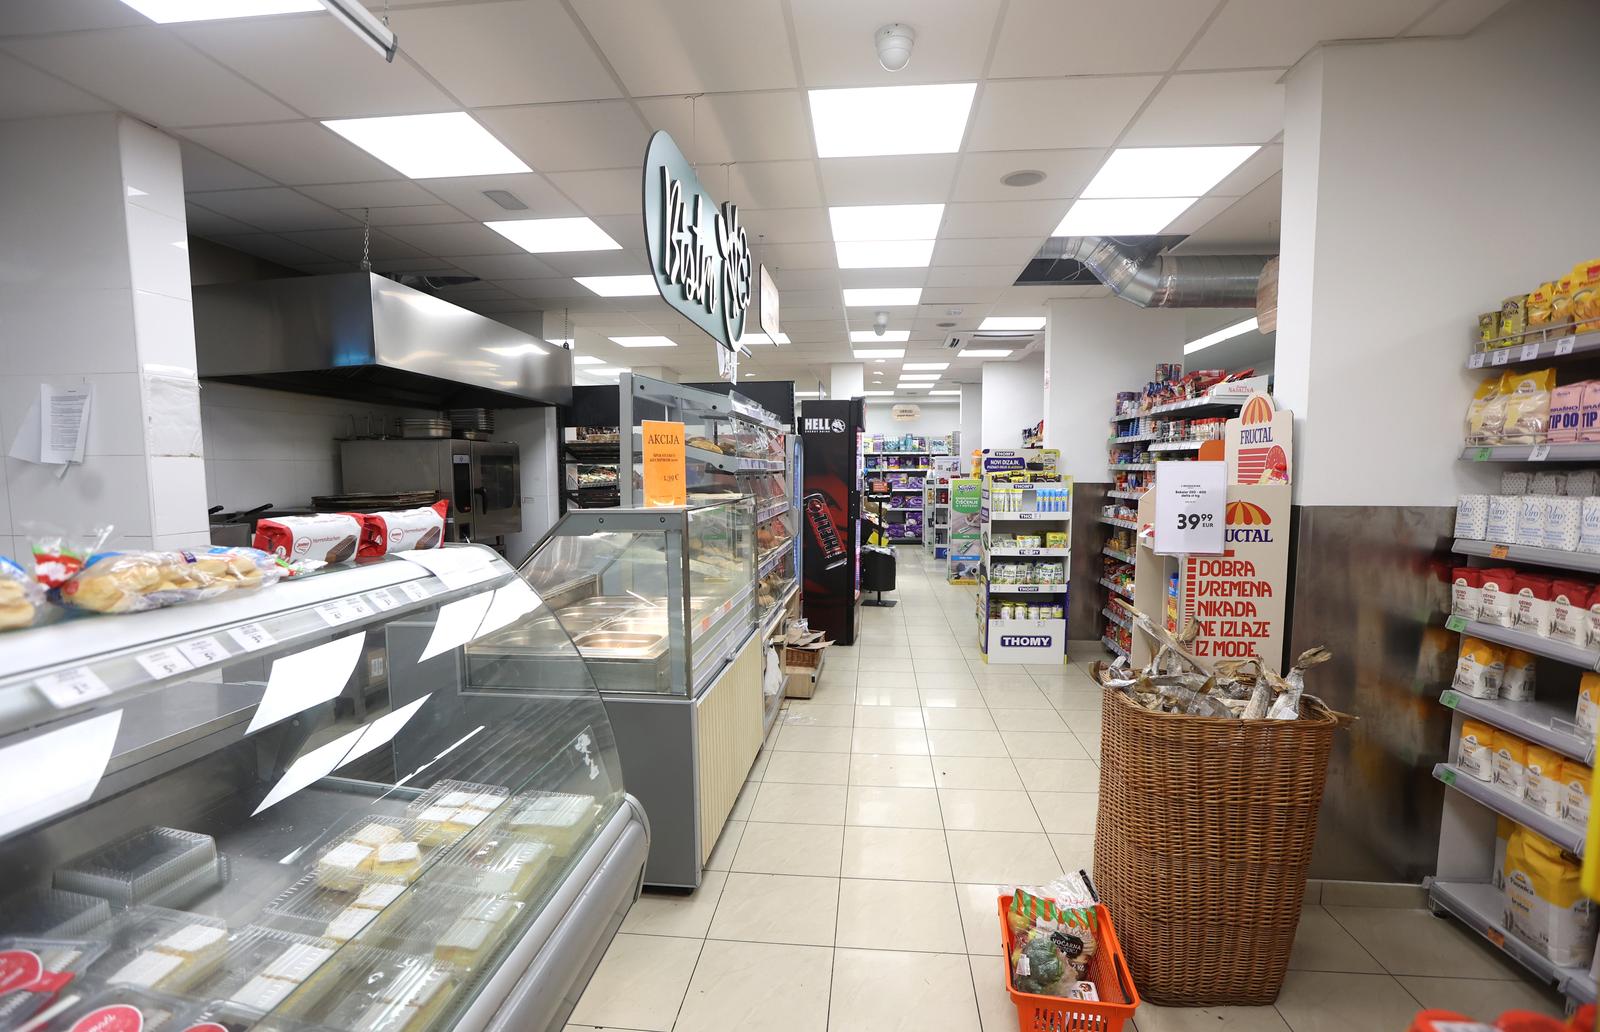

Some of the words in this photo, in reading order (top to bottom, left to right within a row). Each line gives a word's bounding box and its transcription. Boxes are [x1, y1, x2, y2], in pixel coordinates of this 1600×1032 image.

[805, 418, 830, 430] HELL
[1549, 414, 1562, 429] TIP
[1582, 411, 1598, 428] TIP
[648, 434, 680, 445] AKCIJA
[1240, 427, 1273, 445] FRUCTAL
[958, 484, 977, 492] Swiffer
[1201, 513, 1213, 521] 99
[1524, 503, 1539, 516] Viro
[1547, 505, 1563, 519] Viro
[1177, 513, 1200, 529] 39
[812, 513, 841, 551] HELL
[1225, 529, 1273, 542] UCTAL
[1199, 560, 1256, 577] DOBRA
[1198, 581, 1272, 597] VREMENA
[1197, 601, 1257, 617] NIKADA
[1197, 621, 1216, 637] NE
[1220, 621, 1270, 637] IZLAZE
[1002, 637, 1050, 646] THOMY
[1195, 640, 1209, 656] IZ
[1213, 641, 1259, 657] MODE.
[1053, 938, 1081, 951] VOĆARNA
